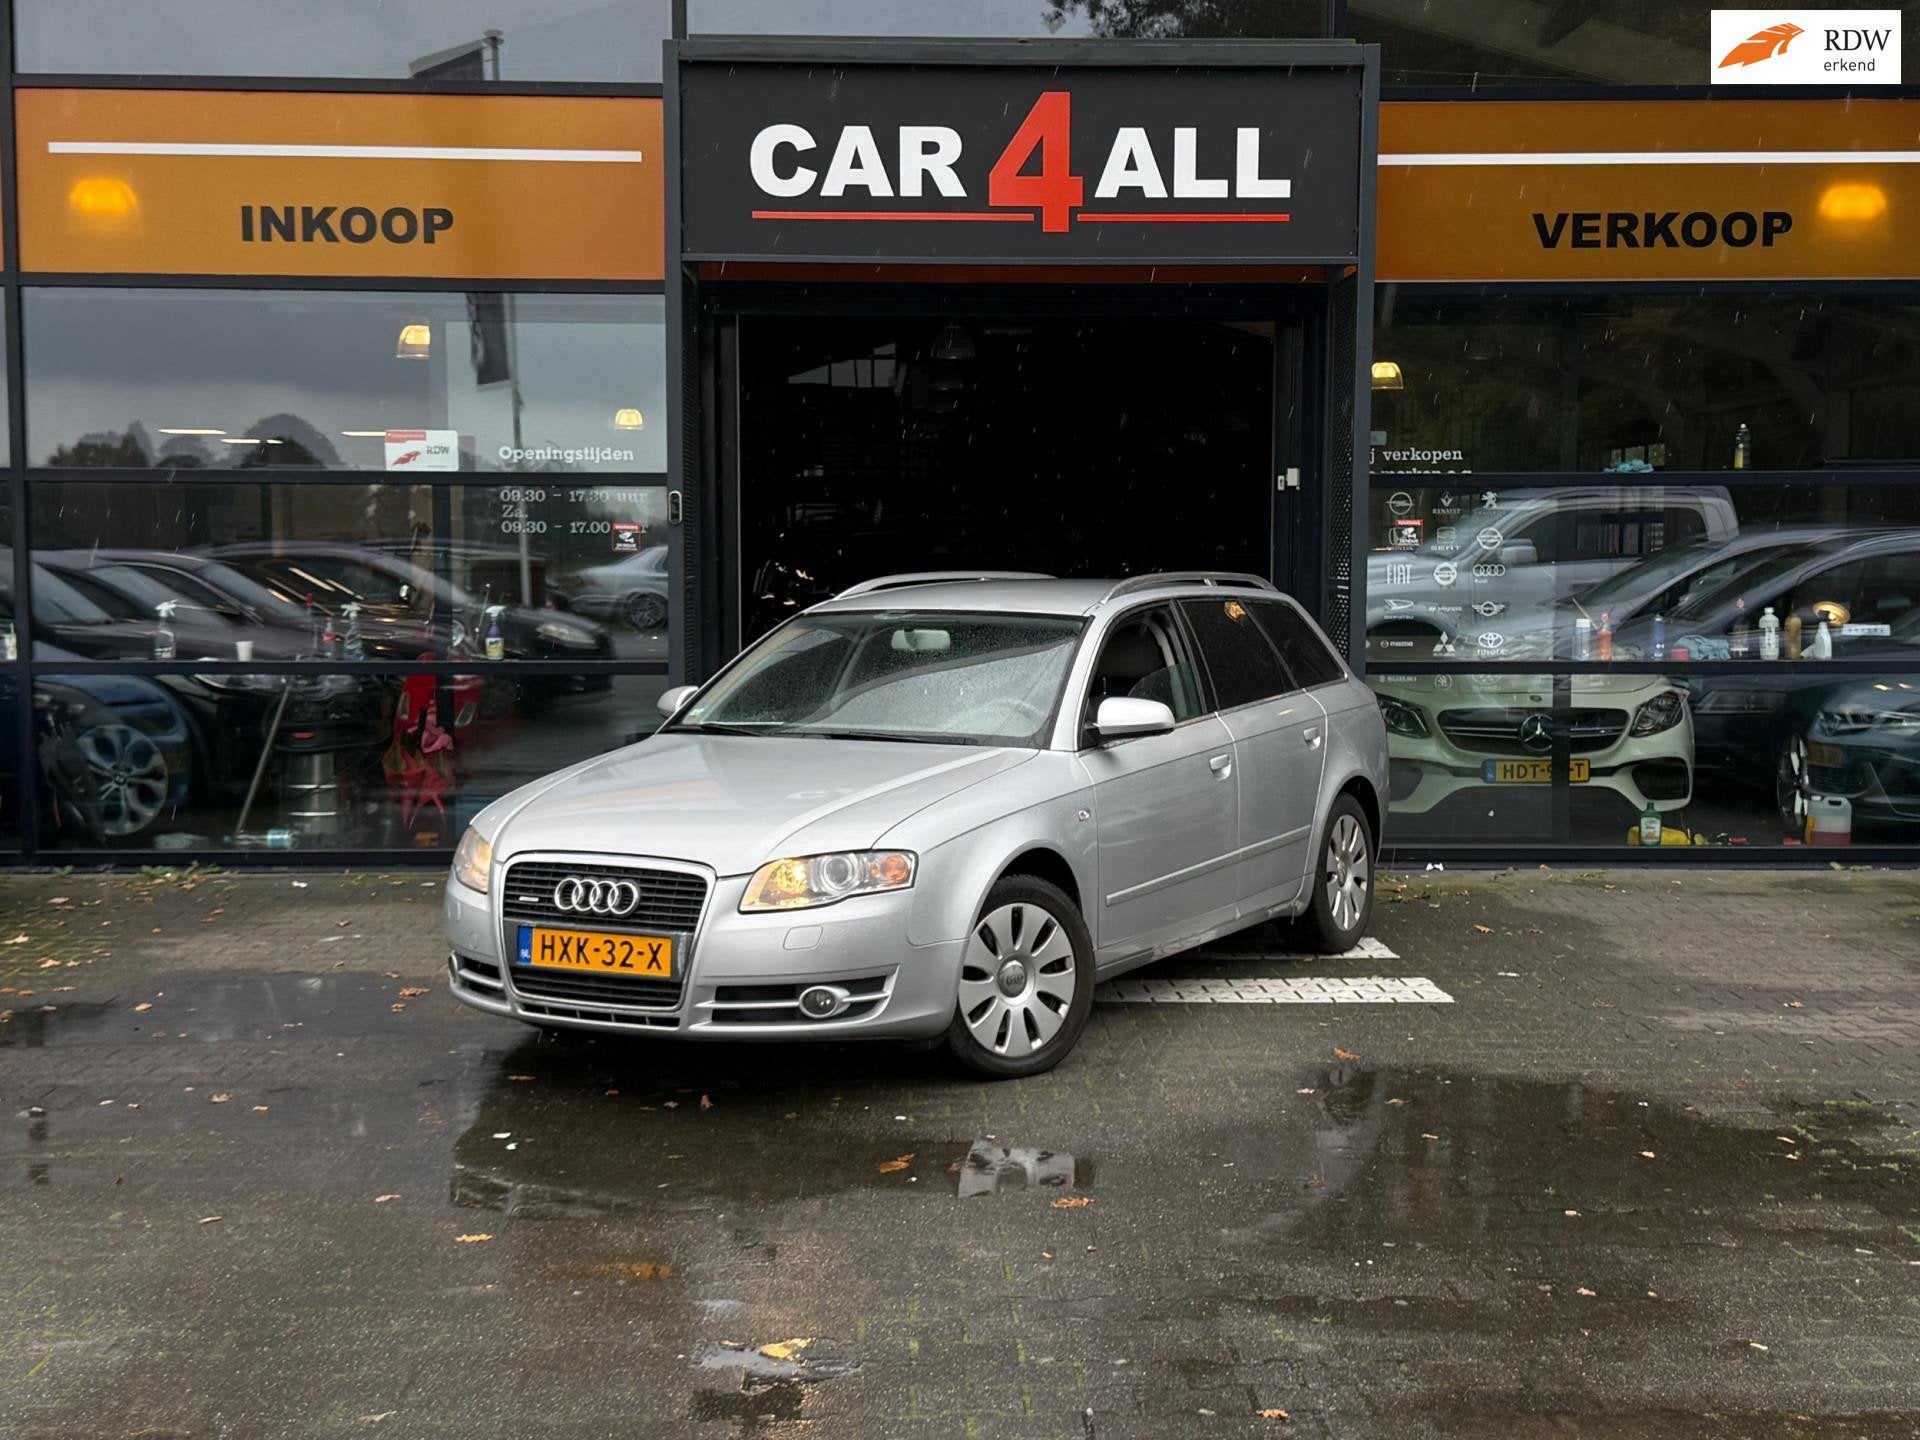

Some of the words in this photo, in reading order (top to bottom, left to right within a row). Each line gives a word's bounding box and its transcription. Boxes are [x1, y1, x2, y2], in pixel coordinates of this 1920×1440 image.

[241, 205, 454, 244] INKOOP
[1532, 211, 1793, 249] VERKOOP
[426, 445, 450, 455] RDW
[499, 446, 634, 463] Openingstijden
[1382, 447, 1464, 464] verkopen
[500, 489, 546, 502] 09.30
[569, 490, 609, 502] 17.30
[617, 492, 648, 503] uur
[502, 504, 529, 518] Za.
[501, 521, 547, 534] 09.30
[569, 522, 611, 534] 17.00
[1386, 564, 1413, 585] FIAT
[540, 934, 663, 971] HXK-32-X
